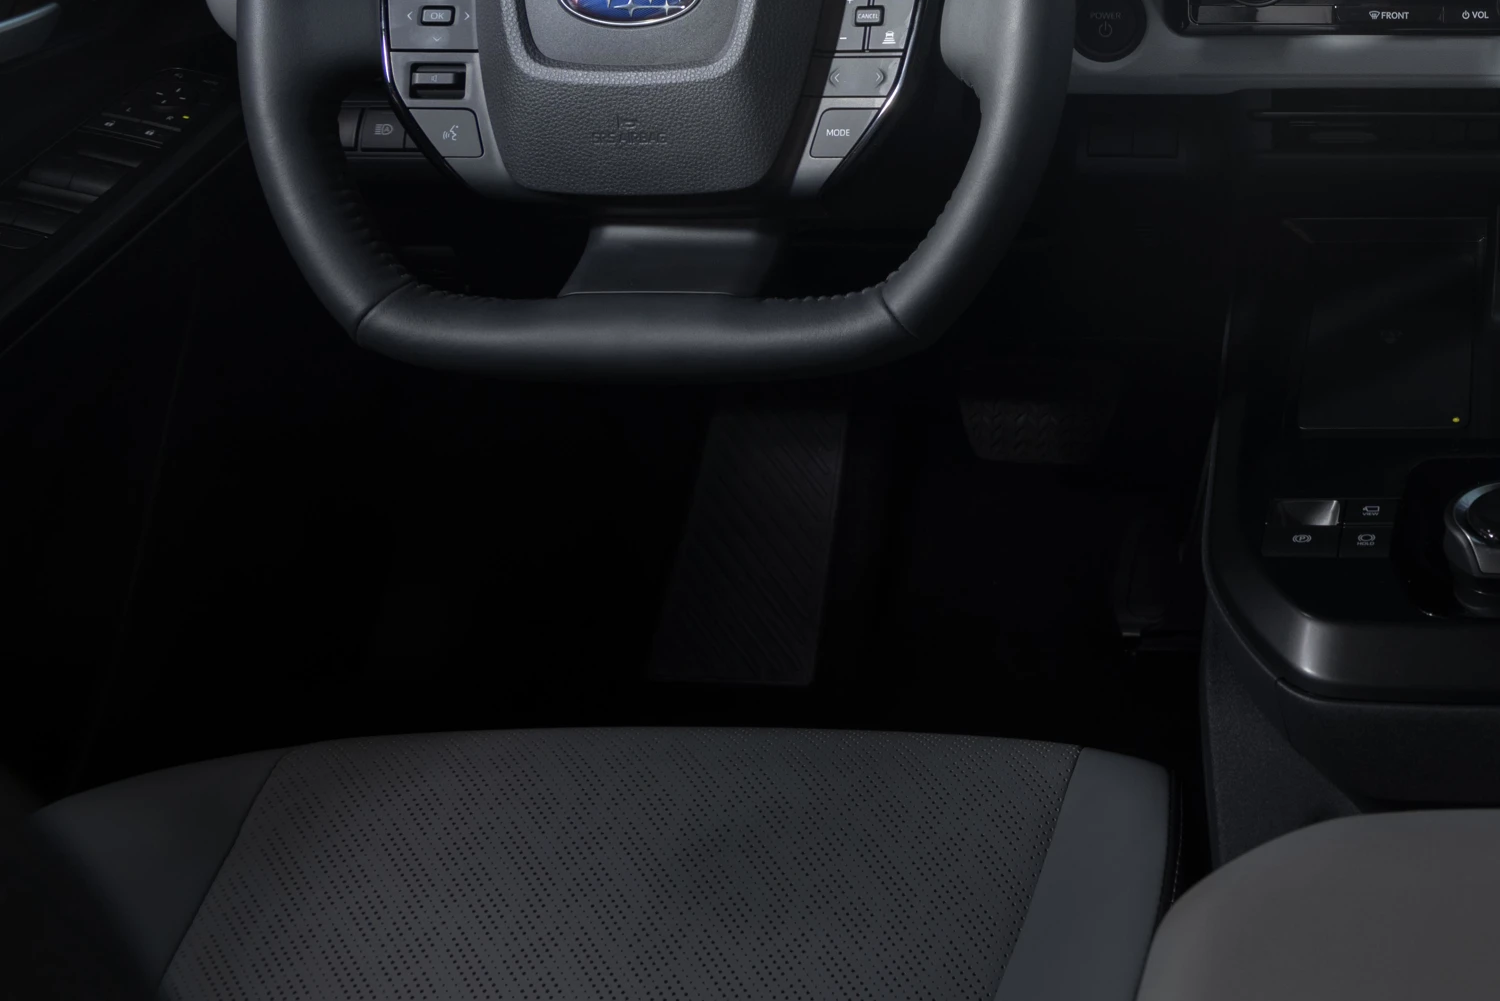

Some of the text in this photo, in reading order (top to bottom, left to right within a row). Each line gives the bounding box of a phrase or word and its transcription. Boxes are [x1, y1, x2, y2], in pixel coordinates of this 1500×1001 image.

[430, 12, 444, 20] OK
[1089, 11, 1122, 19] POWER
[1381, 11, 1409, 20] FRONT
[1471, 11, 1489, 19] VOL
[826, 129, 850, 137] MODE
